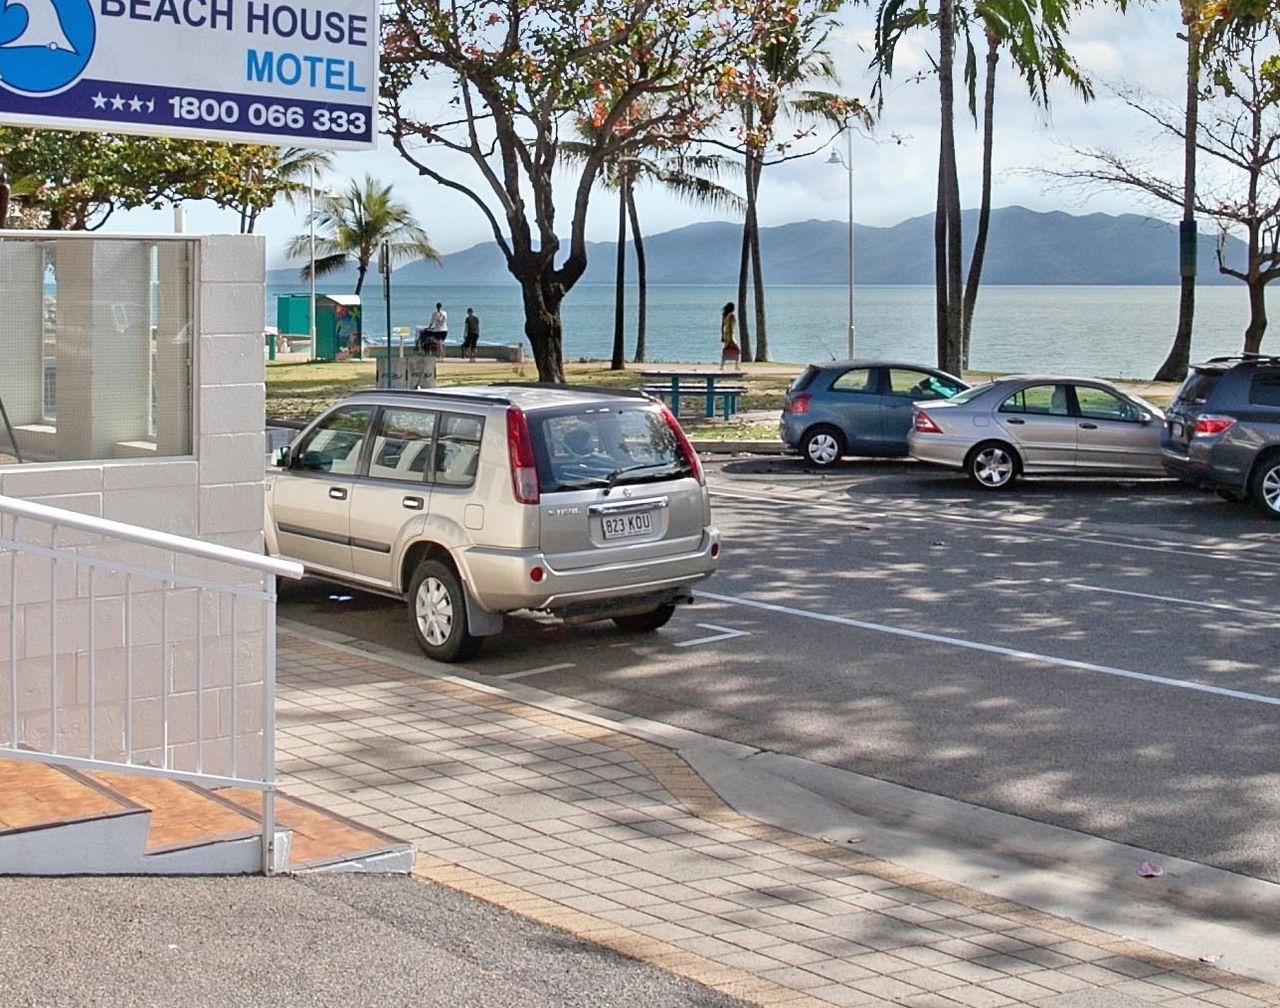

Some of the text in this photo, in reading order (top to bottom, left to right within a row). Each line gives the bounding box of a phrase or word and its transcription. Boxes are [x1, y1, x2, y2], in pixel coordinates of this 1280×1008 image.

[246, 0, 368, 47] HOUSE
[246, 48, 367, 93] MOTEL
[168, 94, 367, 135] 1800 066 333
